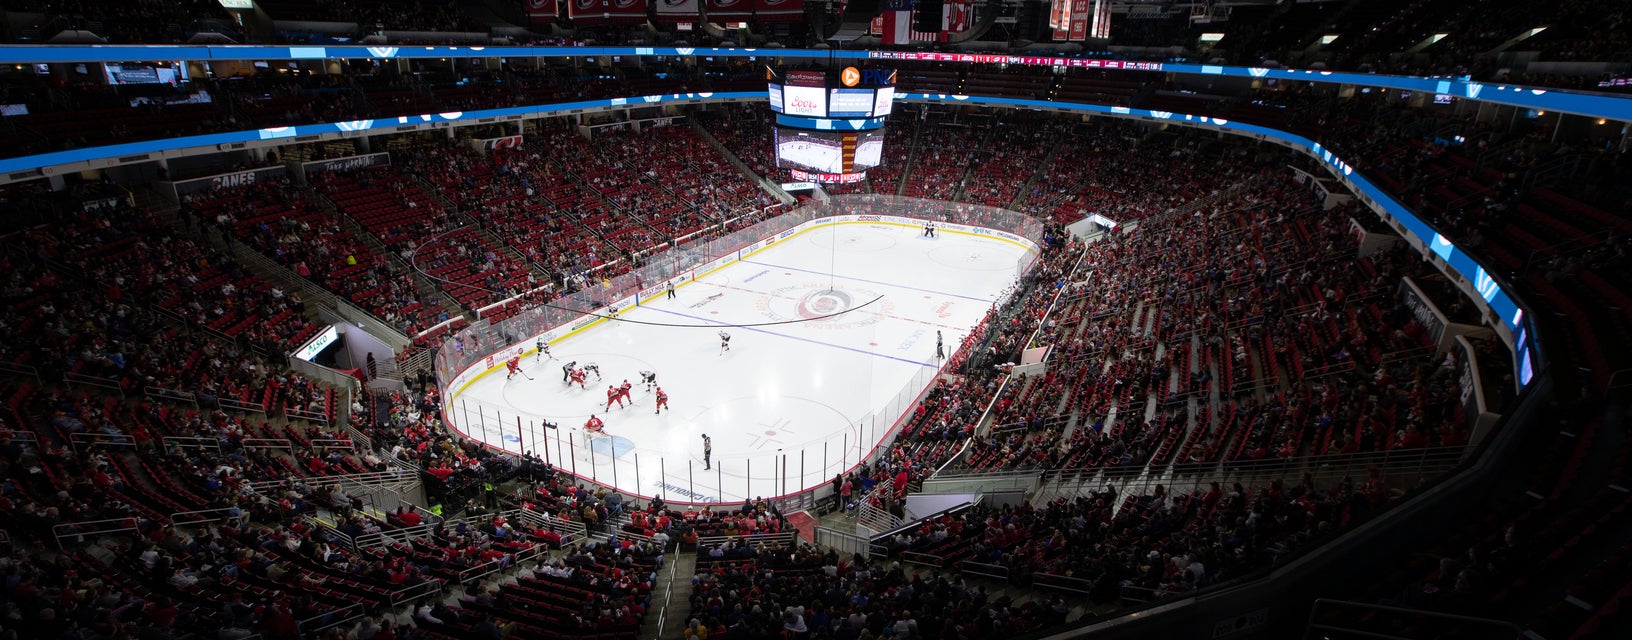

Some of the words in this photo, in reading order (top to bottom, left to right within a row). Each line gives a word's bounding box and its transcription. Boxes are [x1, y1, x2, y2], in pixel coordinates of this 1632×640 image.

[791, 96, 817, 108] Coors
[212, 172, 256, 190] CANES
[780, 228, 795, 239] GEICO
